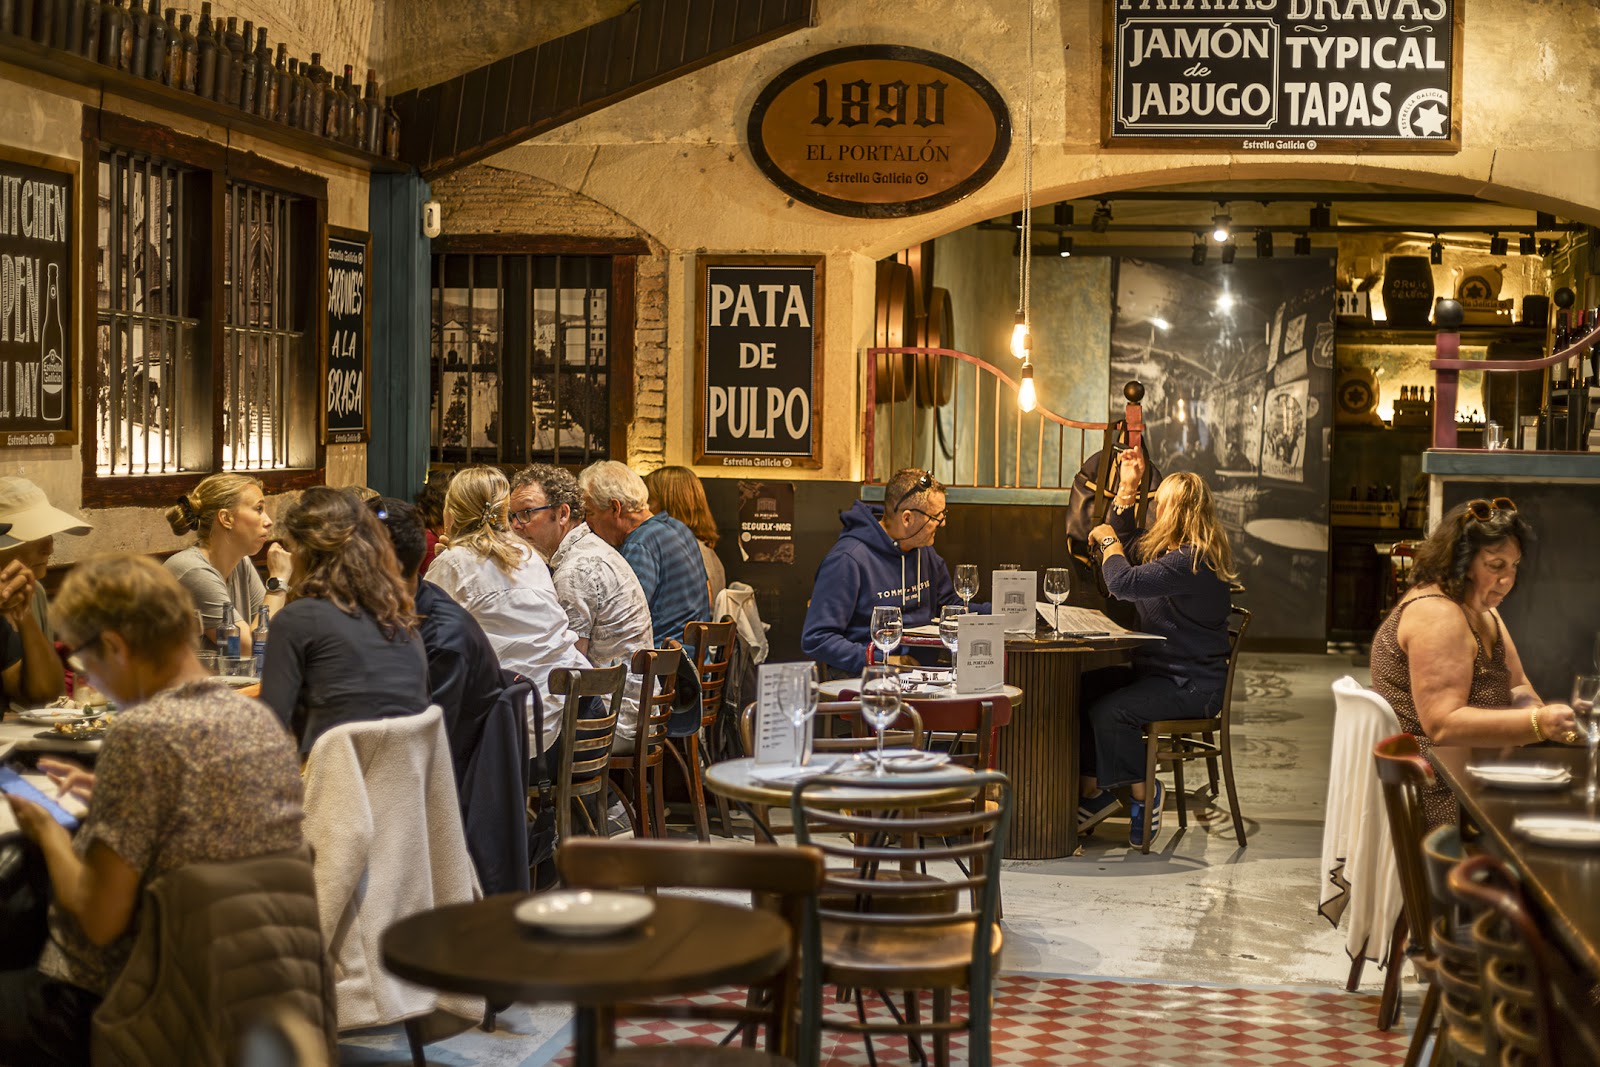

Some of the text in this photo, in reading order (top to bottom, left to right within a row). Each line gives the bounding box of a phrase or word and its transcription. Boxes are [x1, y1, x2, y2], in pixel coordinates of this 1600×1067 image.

[1129, 23, 1269, 67] JAMÓN
[1286, 37, 1446, 70] TYPICAL
[1183, 62, 1212, 77] de
[810, 79, 949, 128] 1890
[1128, 82, 1271, 123] JABUGO
[1284, 82, 1392, 126] TAPAS
[1401, 91, 1443, 130] ESTRELLA GALICIA
[806, 139, 951, 162] EL PORTALÓN
[1242, 140, 1306, 151] Estrella Galicia
[826, 172, 912, 184] Estrella Galicia
[0, 174, 66, 243] ITCHEN
[328, 248, 344, 261] Estrella
[0, 253, 40, 344] PEN
[710, 284, 811, 328] PATA
[331, 329, 357, 360] A LA
[739, 342, 777, 369] DE
[15, 361, 40, 418] DAY
[328, 367, 363, 419] BRASA
[708, 386, 810, 440] PULPO
[7, 433, 47, 446] Estrella Galicia
[723, 457, 781, 467] Estrella Galicia
